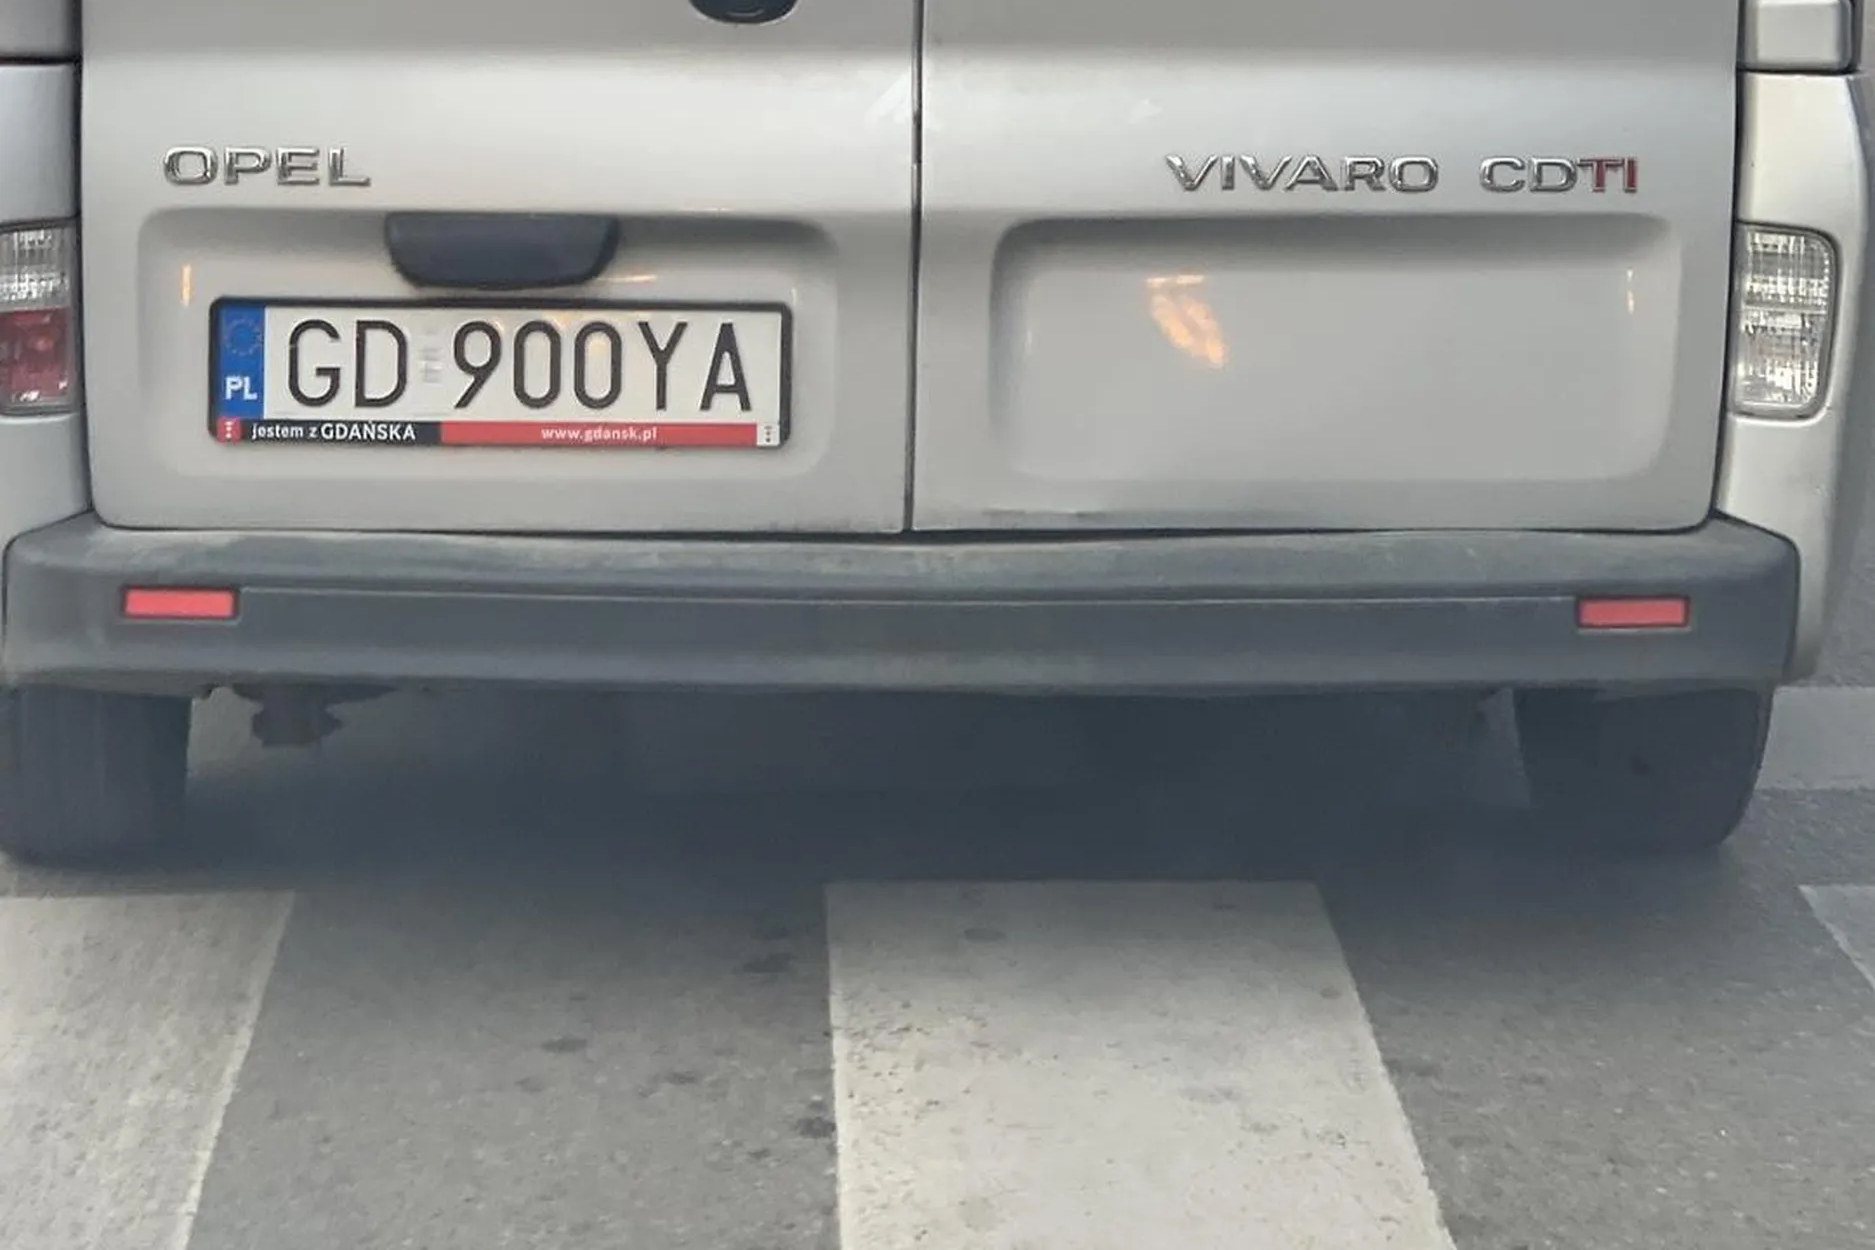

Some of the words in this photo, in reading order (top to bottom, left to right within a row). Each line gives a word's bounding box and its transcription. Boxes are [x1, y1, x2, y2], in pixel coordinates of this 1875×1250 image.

[163, 145, 371, 186] OPEL
[1165, 155, 1440, 193] VIVARO
[1479, 156, 1638, 193] CDTI
[289, 318, 409, 408] GD
[453, 320, 752, 412] 900YA
[225, 377, 258, 401] PL
[252, 423, 304, 440] jestem
[309, 426, 317, 439] z
[320, 419, 416, 441] GDAŃSKA
[541, 426, 658, 442] www.gdansk.pl
